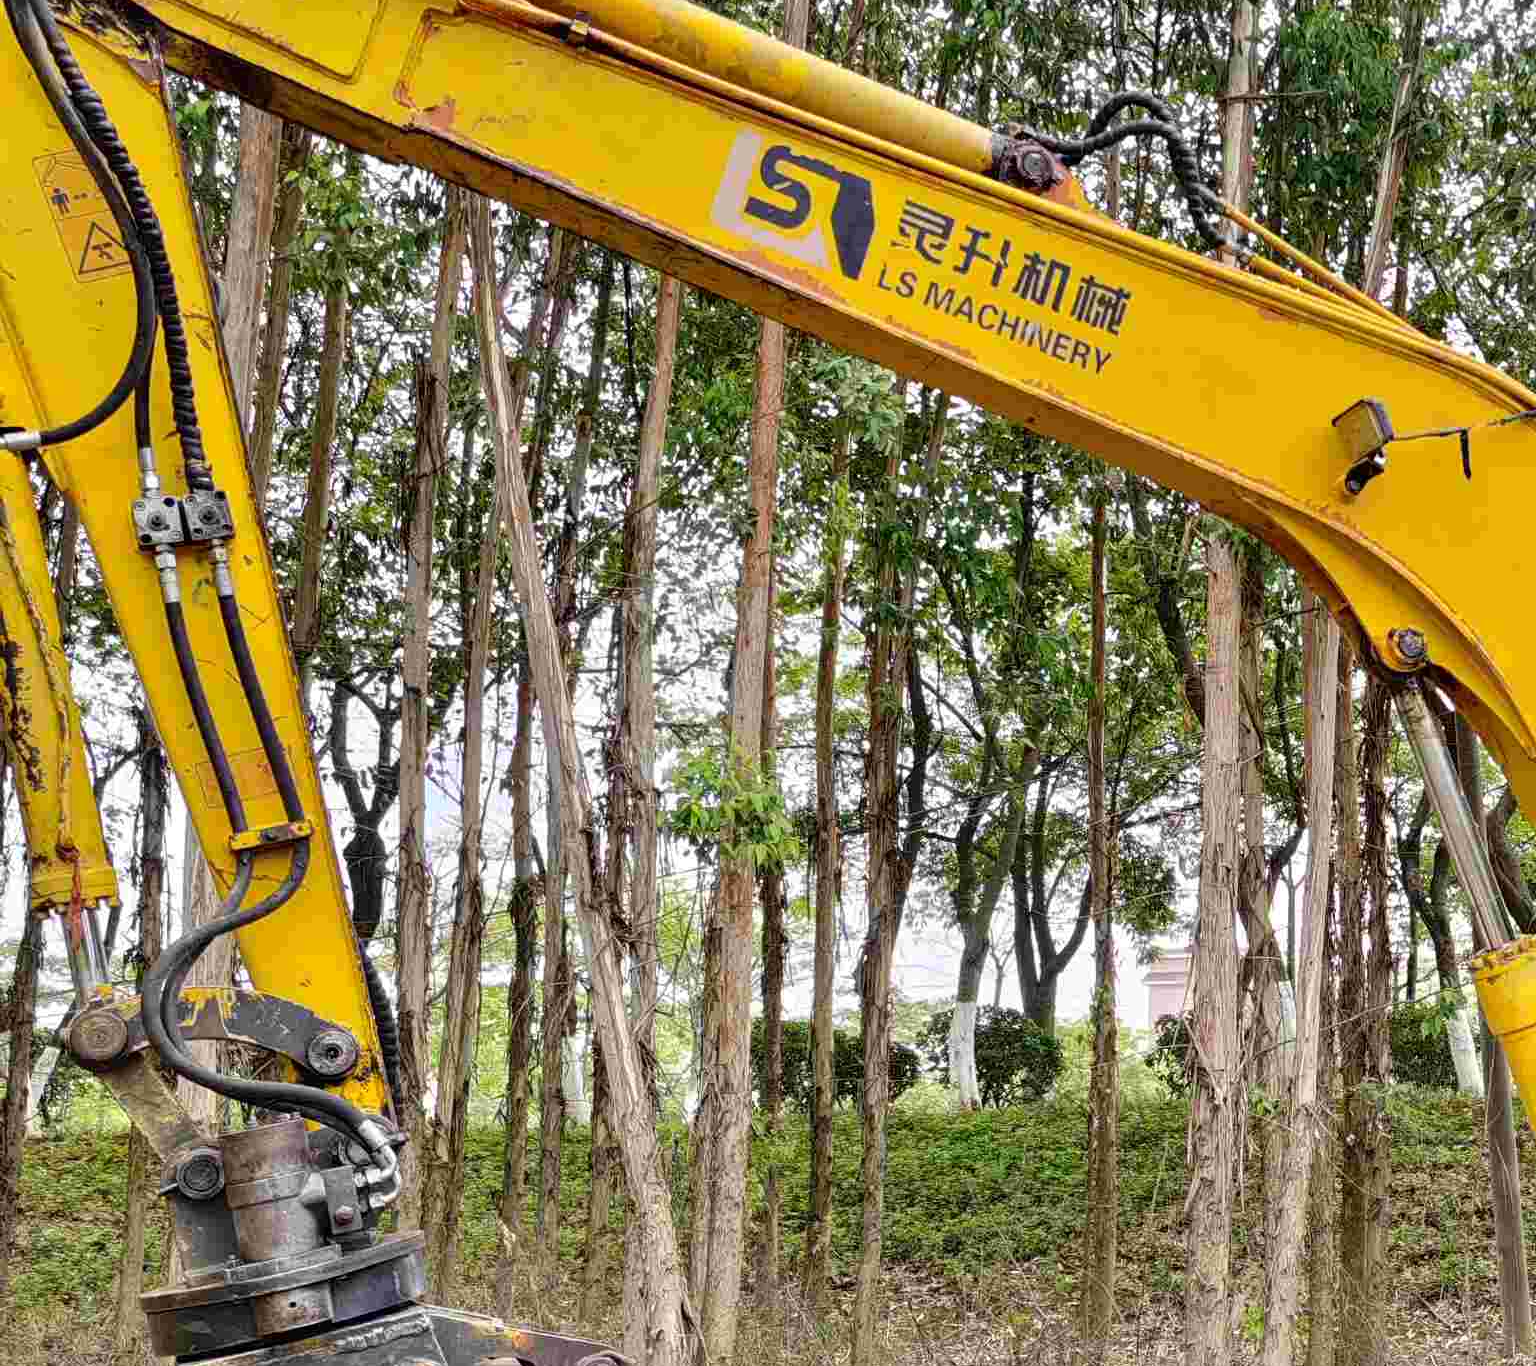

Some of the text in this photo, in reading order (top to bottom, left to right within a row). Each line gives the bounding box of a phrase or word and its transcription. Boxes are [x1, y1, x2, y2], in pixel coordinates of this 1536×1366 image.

[878, 262, 1112, 375] LS MACHINERY
[890, 198, 1131, 336] 灵升机械
